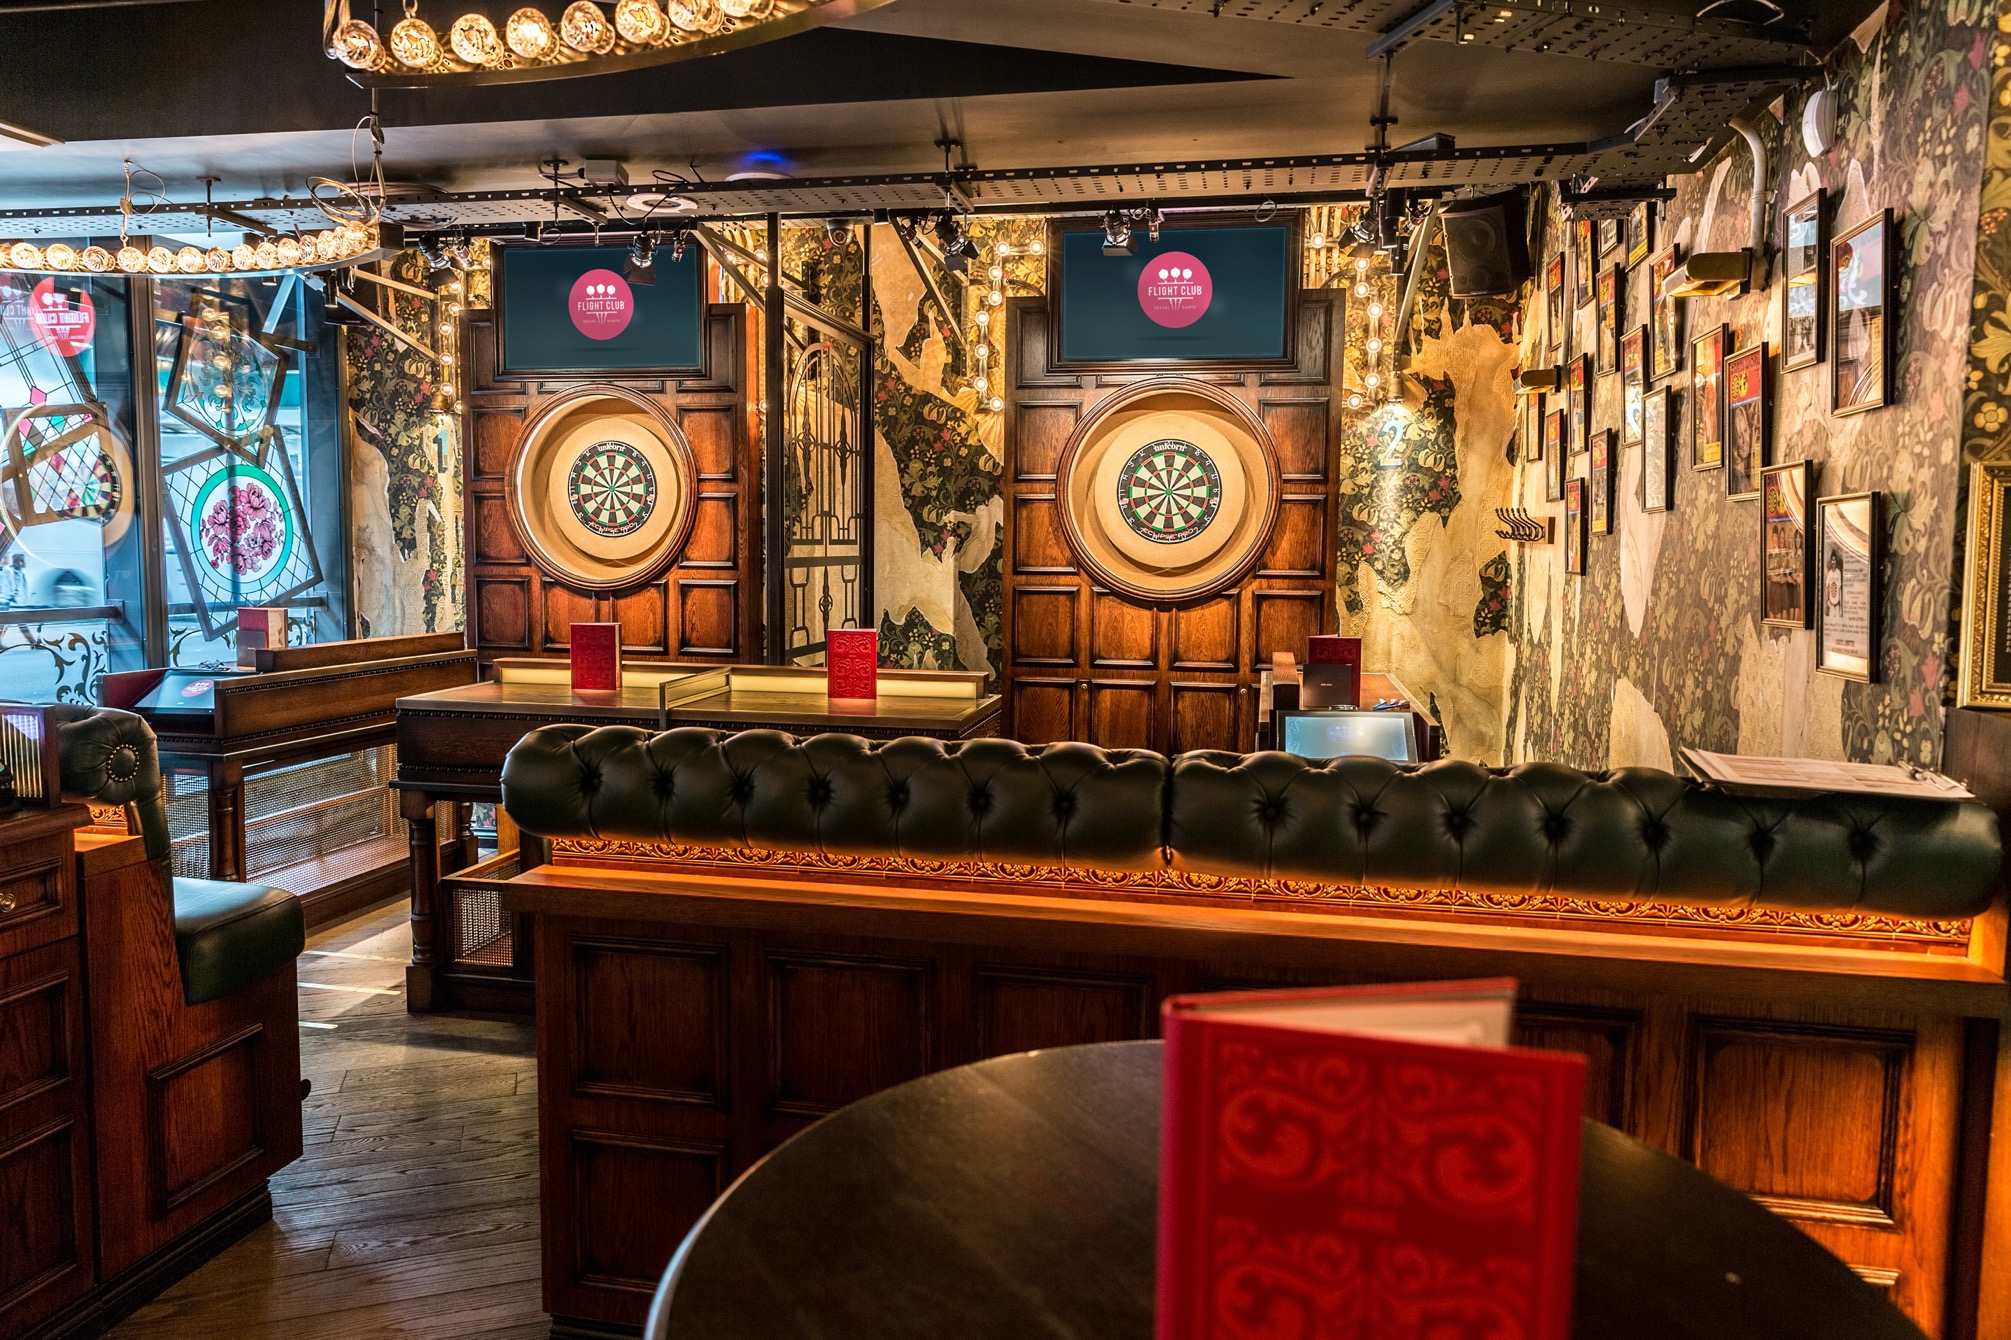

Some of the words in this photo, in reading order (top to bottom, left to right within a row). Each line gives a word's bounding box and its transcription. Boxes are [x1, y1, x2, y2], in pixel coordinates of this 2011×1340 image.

[1148, 285, 1178, 296] FLIGHT
[1181, 285, 1202, 296] CLUB
[577, 301, 604, 311] FLIGHT
[605, 300, 625, 310] CLUB
[1154, 442, 1187, 452] unicorn
[1377, 419, 1404, 470] 2
[433, 429, 448, 473] 1
[1143, 527, 1176, 539] ECLIPSE
